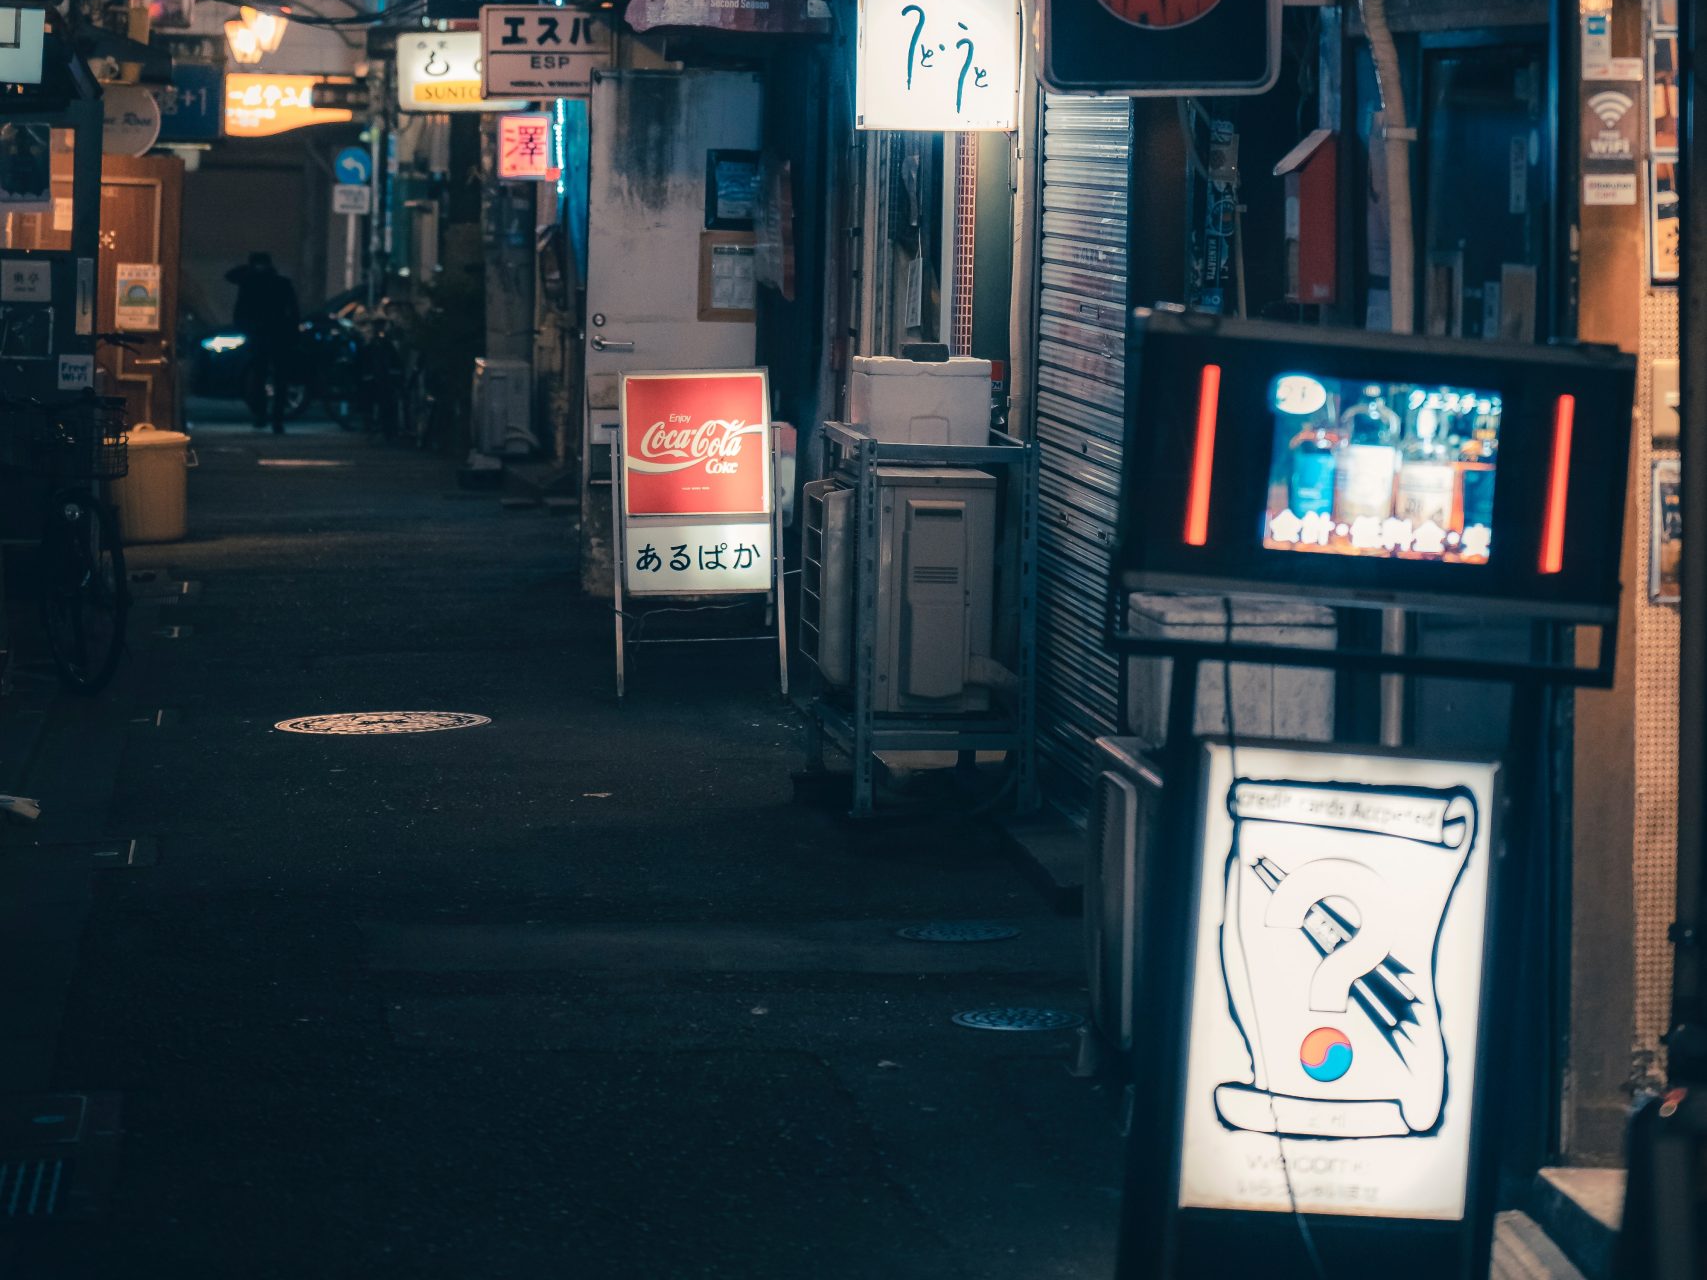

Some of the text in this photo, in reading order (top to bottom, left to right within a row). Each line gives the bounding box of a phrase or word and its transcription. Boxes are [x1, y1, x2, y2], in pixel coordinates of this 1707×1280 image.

[741, 0, 770, 10] Season
[530, 56, 570, 70] ESP
[669, 413, 691, 424] Enjoy
[640, 419, 746, 458] Coca-Cola
[705, 458, 739, 474] Coke
[636, 542, 761, 573] あるぱか
